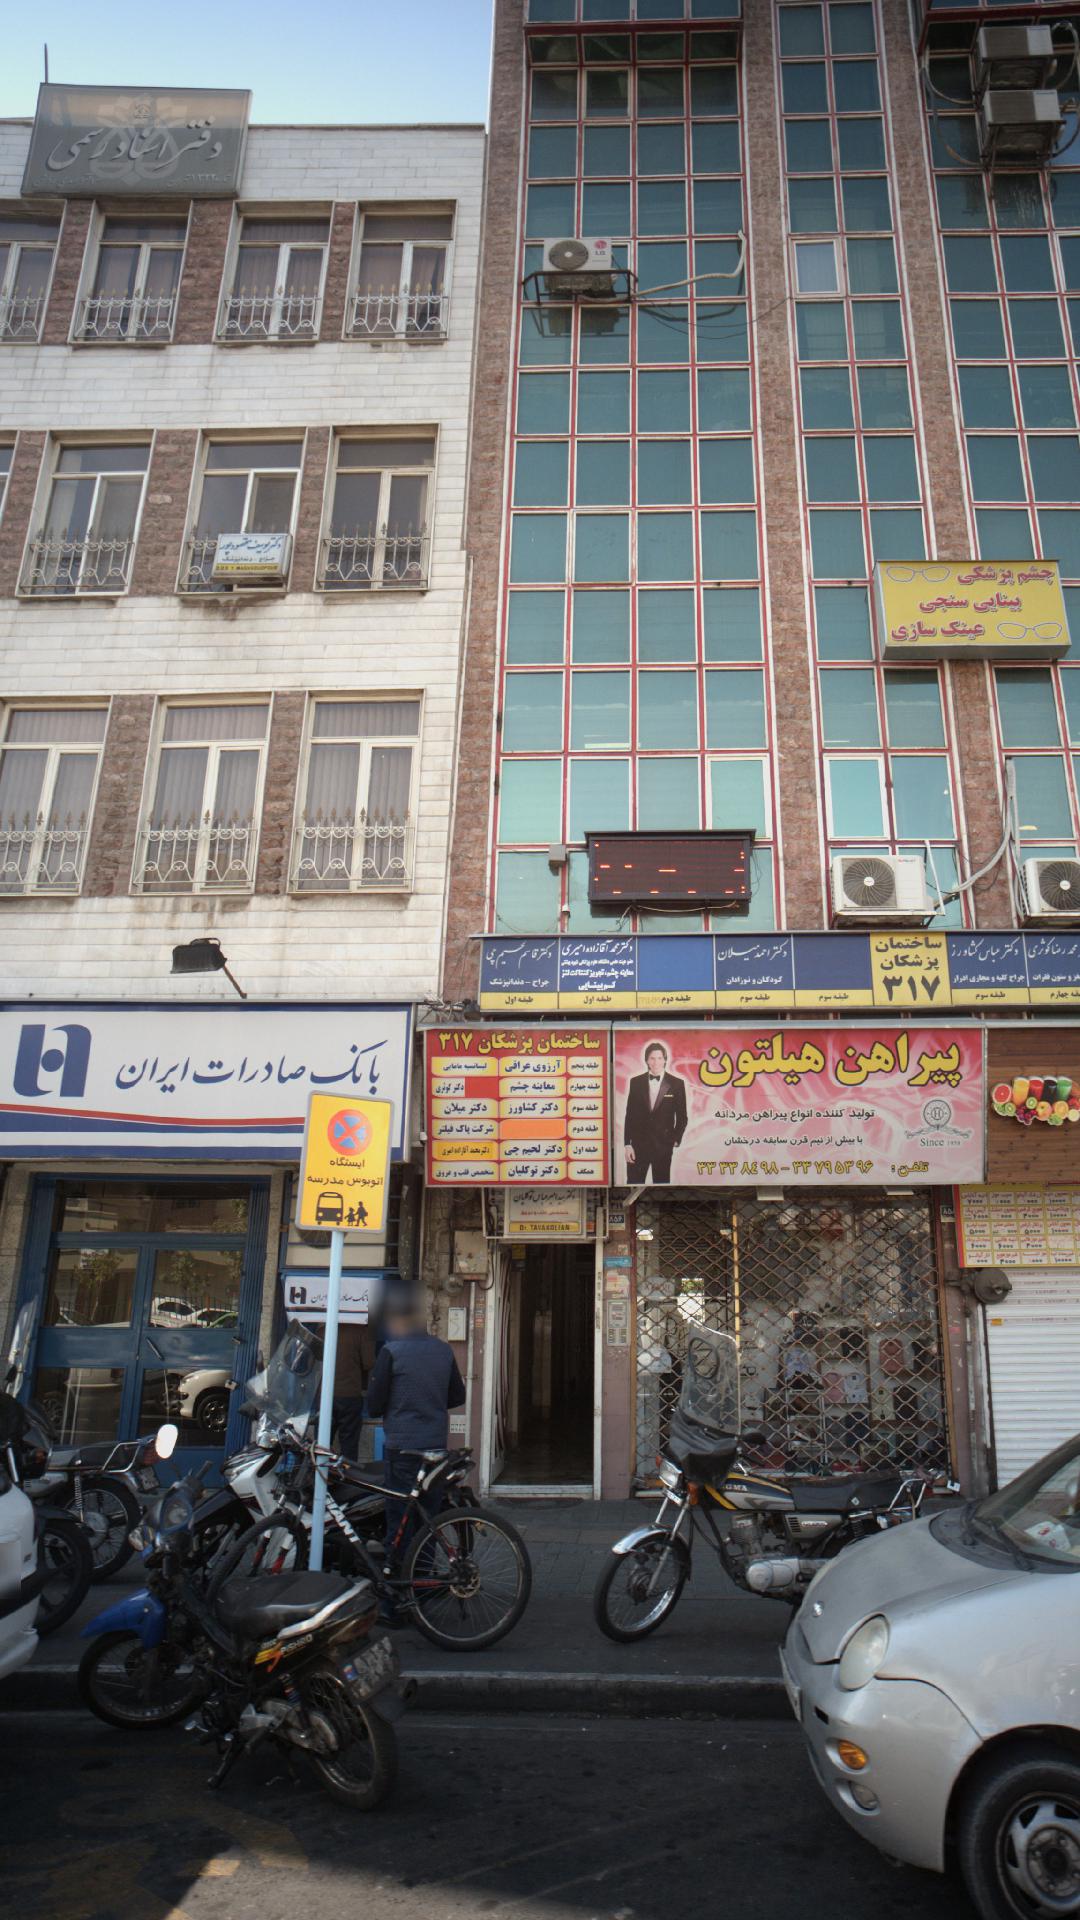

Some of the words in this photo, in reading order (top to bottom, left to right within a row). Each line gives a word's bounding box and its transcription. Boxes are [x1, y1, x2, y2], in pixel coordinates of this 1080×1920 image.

[46, 128, 108, 171] رسمی
[113, 128, 170, 161] اسناد
[153, 116, 222, 171] دفتر
[957, 565, 1014, 585] پزشکی
[1017, 566, 1055, 585] چشم
[919, 594, 969, 613] سنجی
[973, 592, 1023, 613] بینایی
[891, 621, 937, 642] سازی
[941, 621, 986, 640] عینک
[562, 943, 586, 956] امیری
[586, 940, 613, 953] آقازاده
[616, 937, 633, 955] دکتر
[770, 939, 789, 960] دکتر
[875, 936, 943, 953] ساختمان
[951, 938, 984, 957] کشاورز
[1001, 936, 1020, 960] دکتر
[1028, 936, 1056, 958] کوثری
[537, 941, 556, 961] دکتر
[717, 945, 760, 961] میلان
[754, 949, 770, 958] احمد
[978, 945, 1000, 963] عباس
[880, 954, 940, 971] پزشکان
[620, 968, 634, 977] معاینه
[969, 974, 991, 983] مجاری
[1009, 974, 1025, 983] جراح
[489, 977, 525, 988] دندانپزشک
[533, 978, 550, 988] جراح
[726, 976, 751, 985] نوزادان
[757, 976, 782, 984] کودکان
[883, 975, 941, 1001] ۳۱۷
[505, 996, 517, 1005] اول
[583, 996, 594, 1005] اول
[661, 996, 674, 1005] دوم
[675, 995, 691, 1003] طبقه
[1050, 990, 1068, 999] چهارم
[439, 1032, 473, 1050] ۳۱۷
[478, 1032, 534, 1054] پزشکان
[537, 1031, 600, 1053] ساختمان
[698, 1032, 826, 1087] هیلتون
[836, 1032, 963, 1088] پیراهن
[193, 1055, 305, 1084] صادرات
[309, 1040, 388, 1095] بانک
[504, 1060, 530, 1072] عراقی
[532, 1060, 561, 1072] آرزوی
[571, 1063, 584, 1071] پنجم
[115, 1056, 191, 1094] ایران
[435, 1082, 452, 1094] کوثری
[453, 1083, 464, 1093] دکتر
[510, 1081, 530, 1093] چشم
[532, 1081, 555, 1092] معاینه
[570, 1083, 586, 1092] چهارم
[444, 1103, 466, 1115] میلان
[468, 1103, 487, 1114] دکتر
[508, 1102, 538, 1114] کشاورز
[540, 1102, 558, 1114] دکتر
[816, 1109, 845, 1118] کننده
[715, 1110, 750, 1121] مردانه
[752, 1109, 787, 1122] پیراهن
[790, 1109, 813, 1122] انواع
[849, 1109, 875, 1121] تولید
[438, 1124, 454, 1135] فیلتر
[473, 1124, 494, 1135] شرکت
[572, 1125, 584, 1133] دوم
[724, 1136, 760, 1146] درخشان
[763, 1136, 788, 1144] سابقه
[790, 1136, 808, 1145] قرن
[809, 1137, 824, 1147] نیم
[825, 1136, 833, 1145] از
[835, 1136, 855, 1146] بیش
[856, 1136, 863, 1145] با
[920, 1138, 944, 1147] Since
[544, 1145, 562, 1156] دکتر
[573, 1146, 584, 1154] اول
[329, 1157, 365, 1170] ایستگاه
[898, 1161, 929, 1177] تلفن
[508, 1165, 538, 1177] توکلیان
[540, 1165, 559, 1177] دکتر
[576, 1167, 594, 1175] همکف
[307, 1175, 344, 1186] مدرسه
[346, 1176, 383, 1188] اتوبوس
